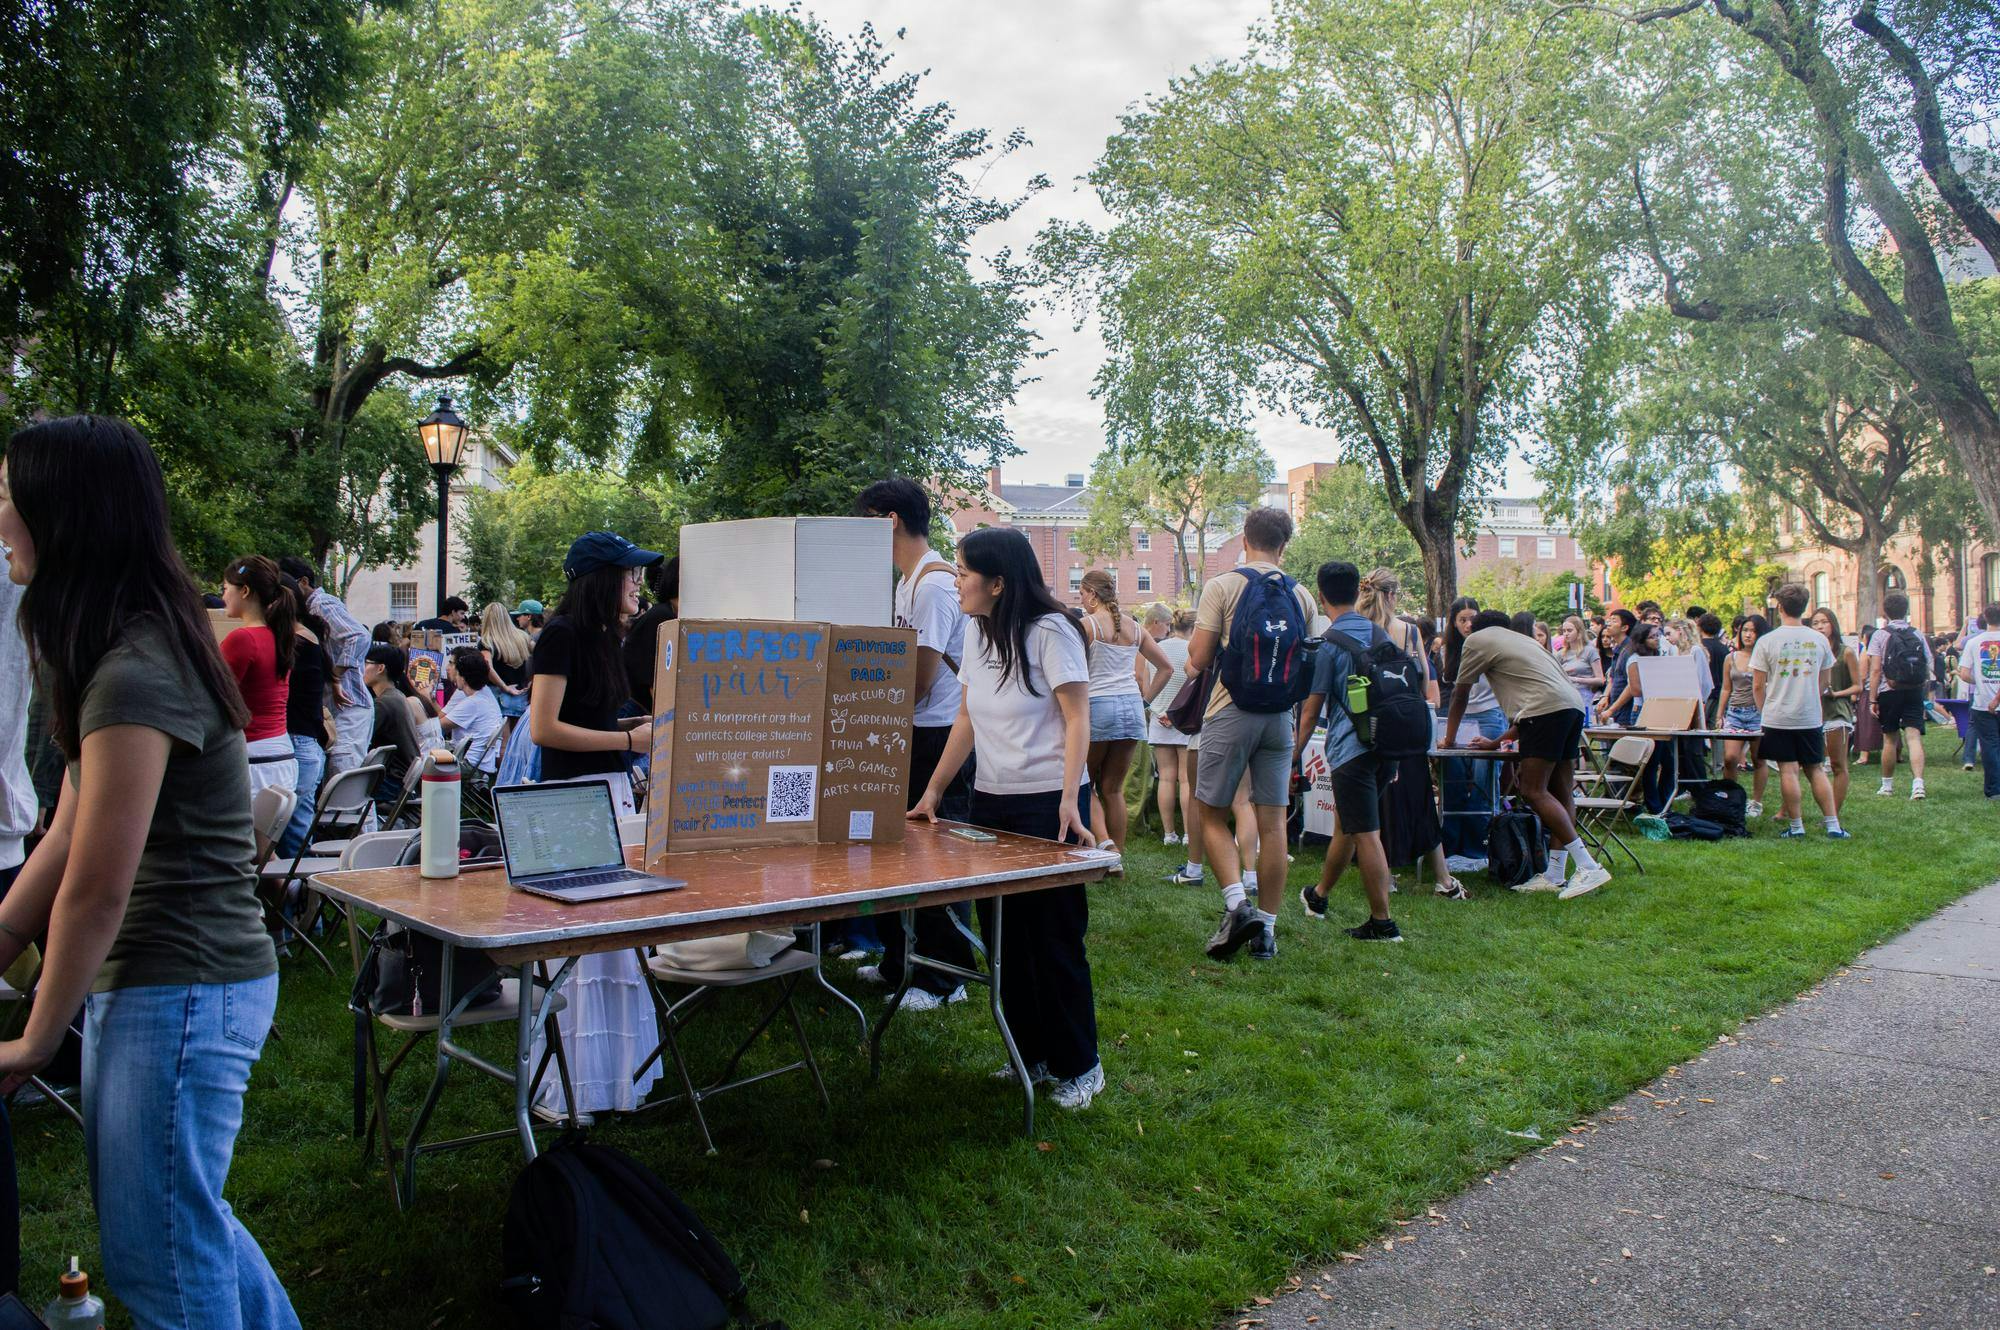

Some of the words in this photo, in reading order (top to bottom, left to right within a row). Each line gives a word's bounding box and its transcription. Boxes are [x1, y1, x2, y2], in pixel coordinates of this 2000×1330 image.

[453, 635, 469, 644] THE
[687, 628, 823, 663] PERFECT
[835, 638, 907, 655] ACTIVITIES
[850, 667, 892, 682] PAIR:
[702, 666, 823, 709] pair
[833, 691, 859, 705] BOOK
[860, 688, 886, 701] CLUB
[688, 711, 698, 722] is
[702, 711, 710, 721] a
[714, 711, 767, 724] nonprofit
[769, 712, 786, 724] org
[789, 712, 812, 724] that
[850, 714, 909, 728] GARDENING
[685, 730, 732, 741] connects
[735, 730, 768, 742] college
[770, 730, 813, 742] students
[830, 739, 863, 750] TRIVIA
[695, 750, 719, 763] with
[721, 749, 749, 761] older
[859, 761, 898, 778] GAMES
[823, 784, 849, 798] ARTS
[860, 782, 900, 795] CRAFTS
[710, 813, 738, 830] JOIN
